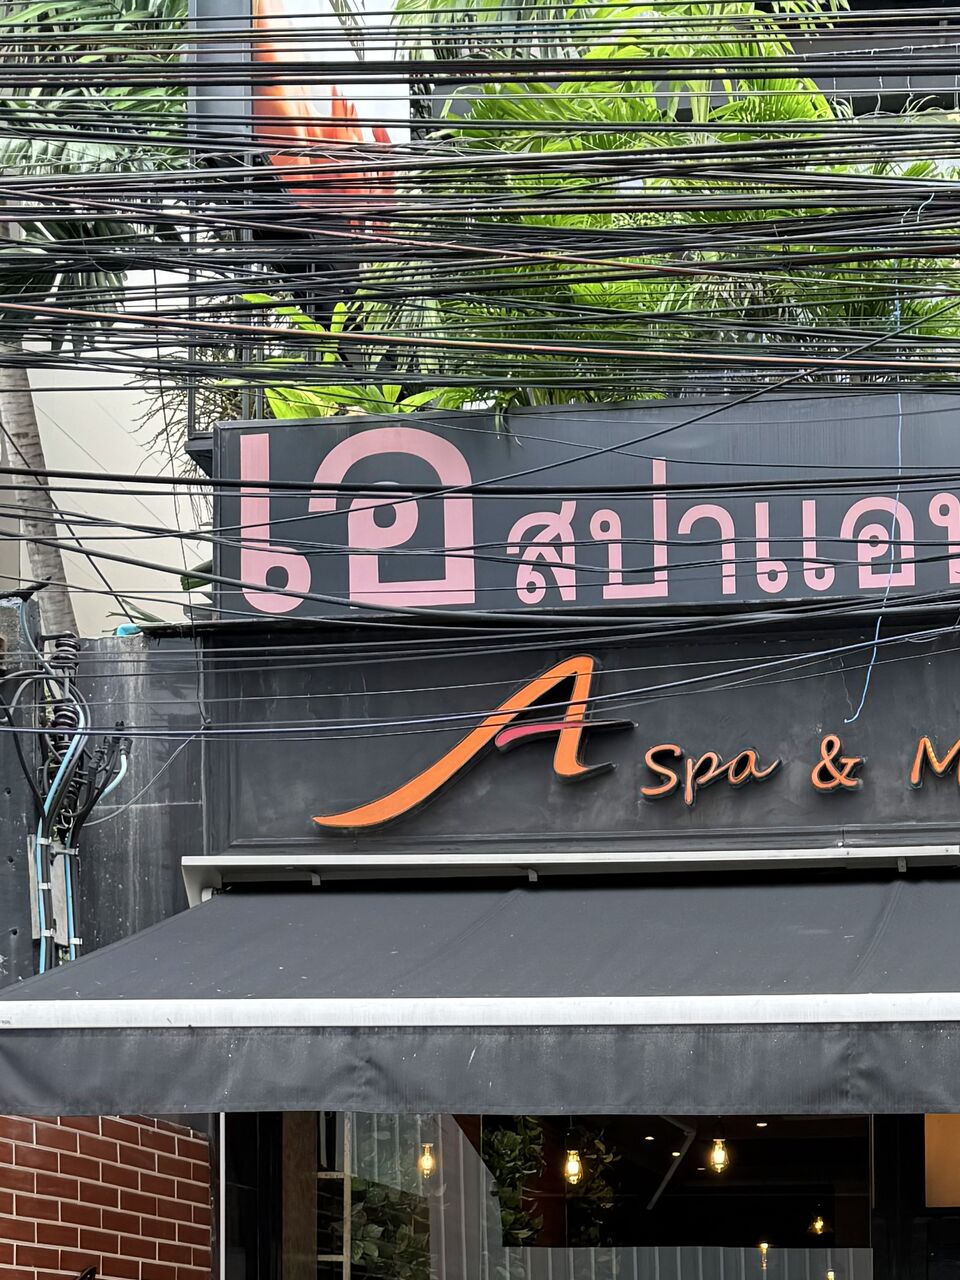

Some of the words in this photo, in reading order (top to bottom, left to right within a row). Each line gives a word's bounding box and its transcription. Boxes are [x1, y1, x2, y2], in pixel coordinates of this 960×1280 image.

[312, 654, 634, 830] A
[641, 743, 780, 806] Spa
[811, 733, 862, 792] &
